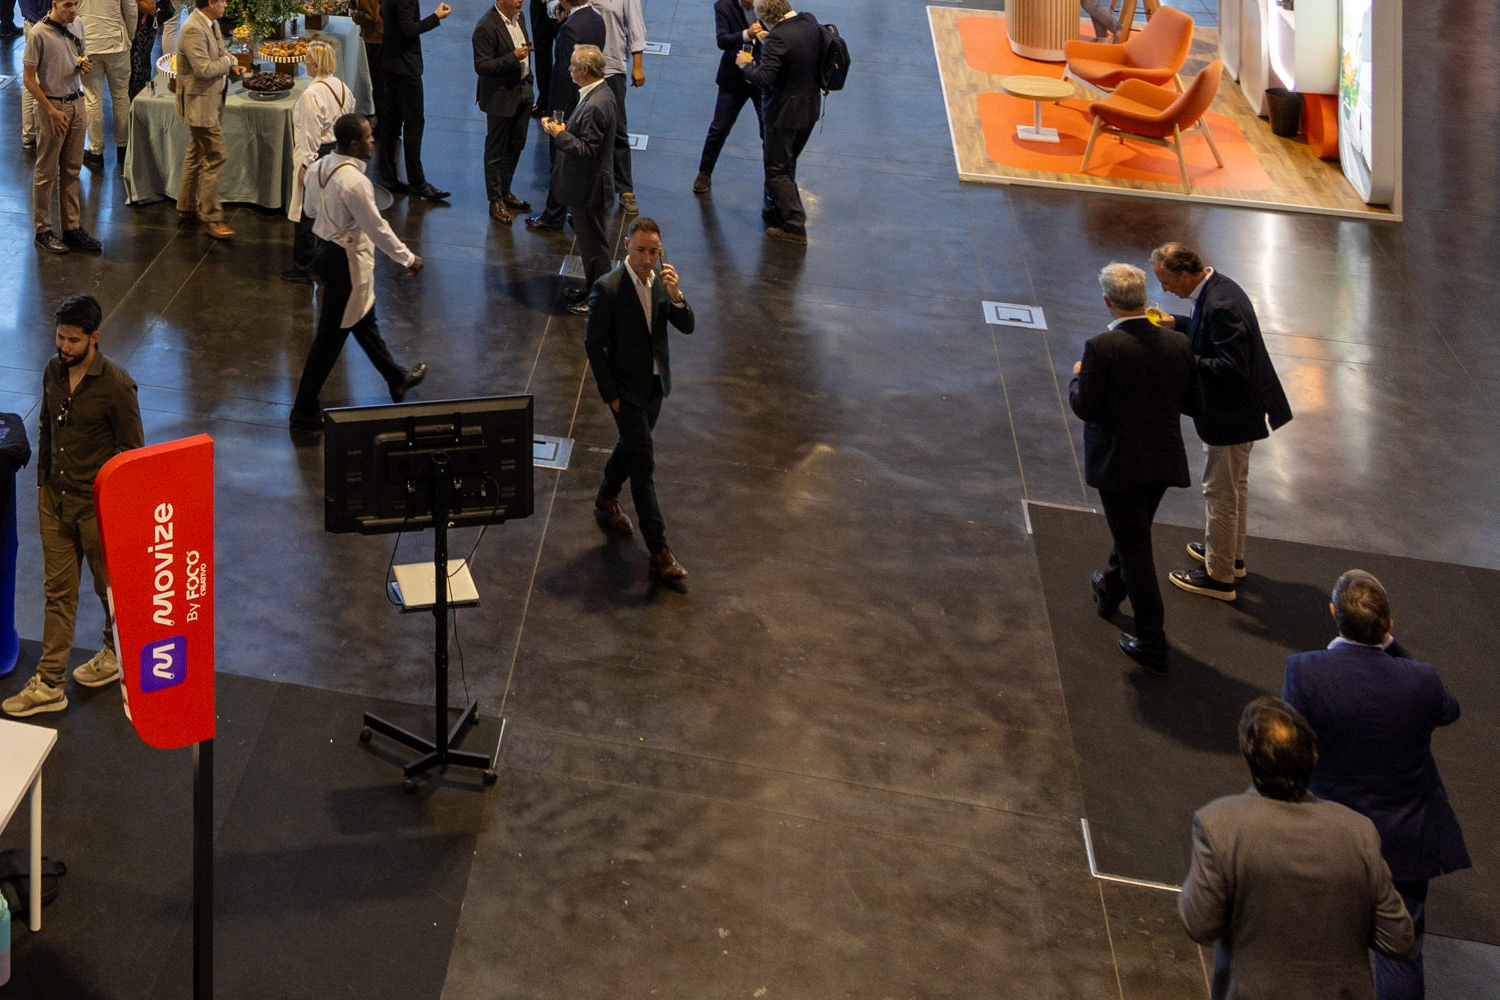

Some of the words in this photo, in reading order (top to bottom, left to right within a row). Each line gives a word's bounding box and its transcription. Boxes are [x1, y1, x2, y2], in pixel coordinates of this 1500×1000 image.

[148, 502, 175, 626] Movize
[186, 550, 200, 600] FOCO
[186, 603, 201, 623] By
